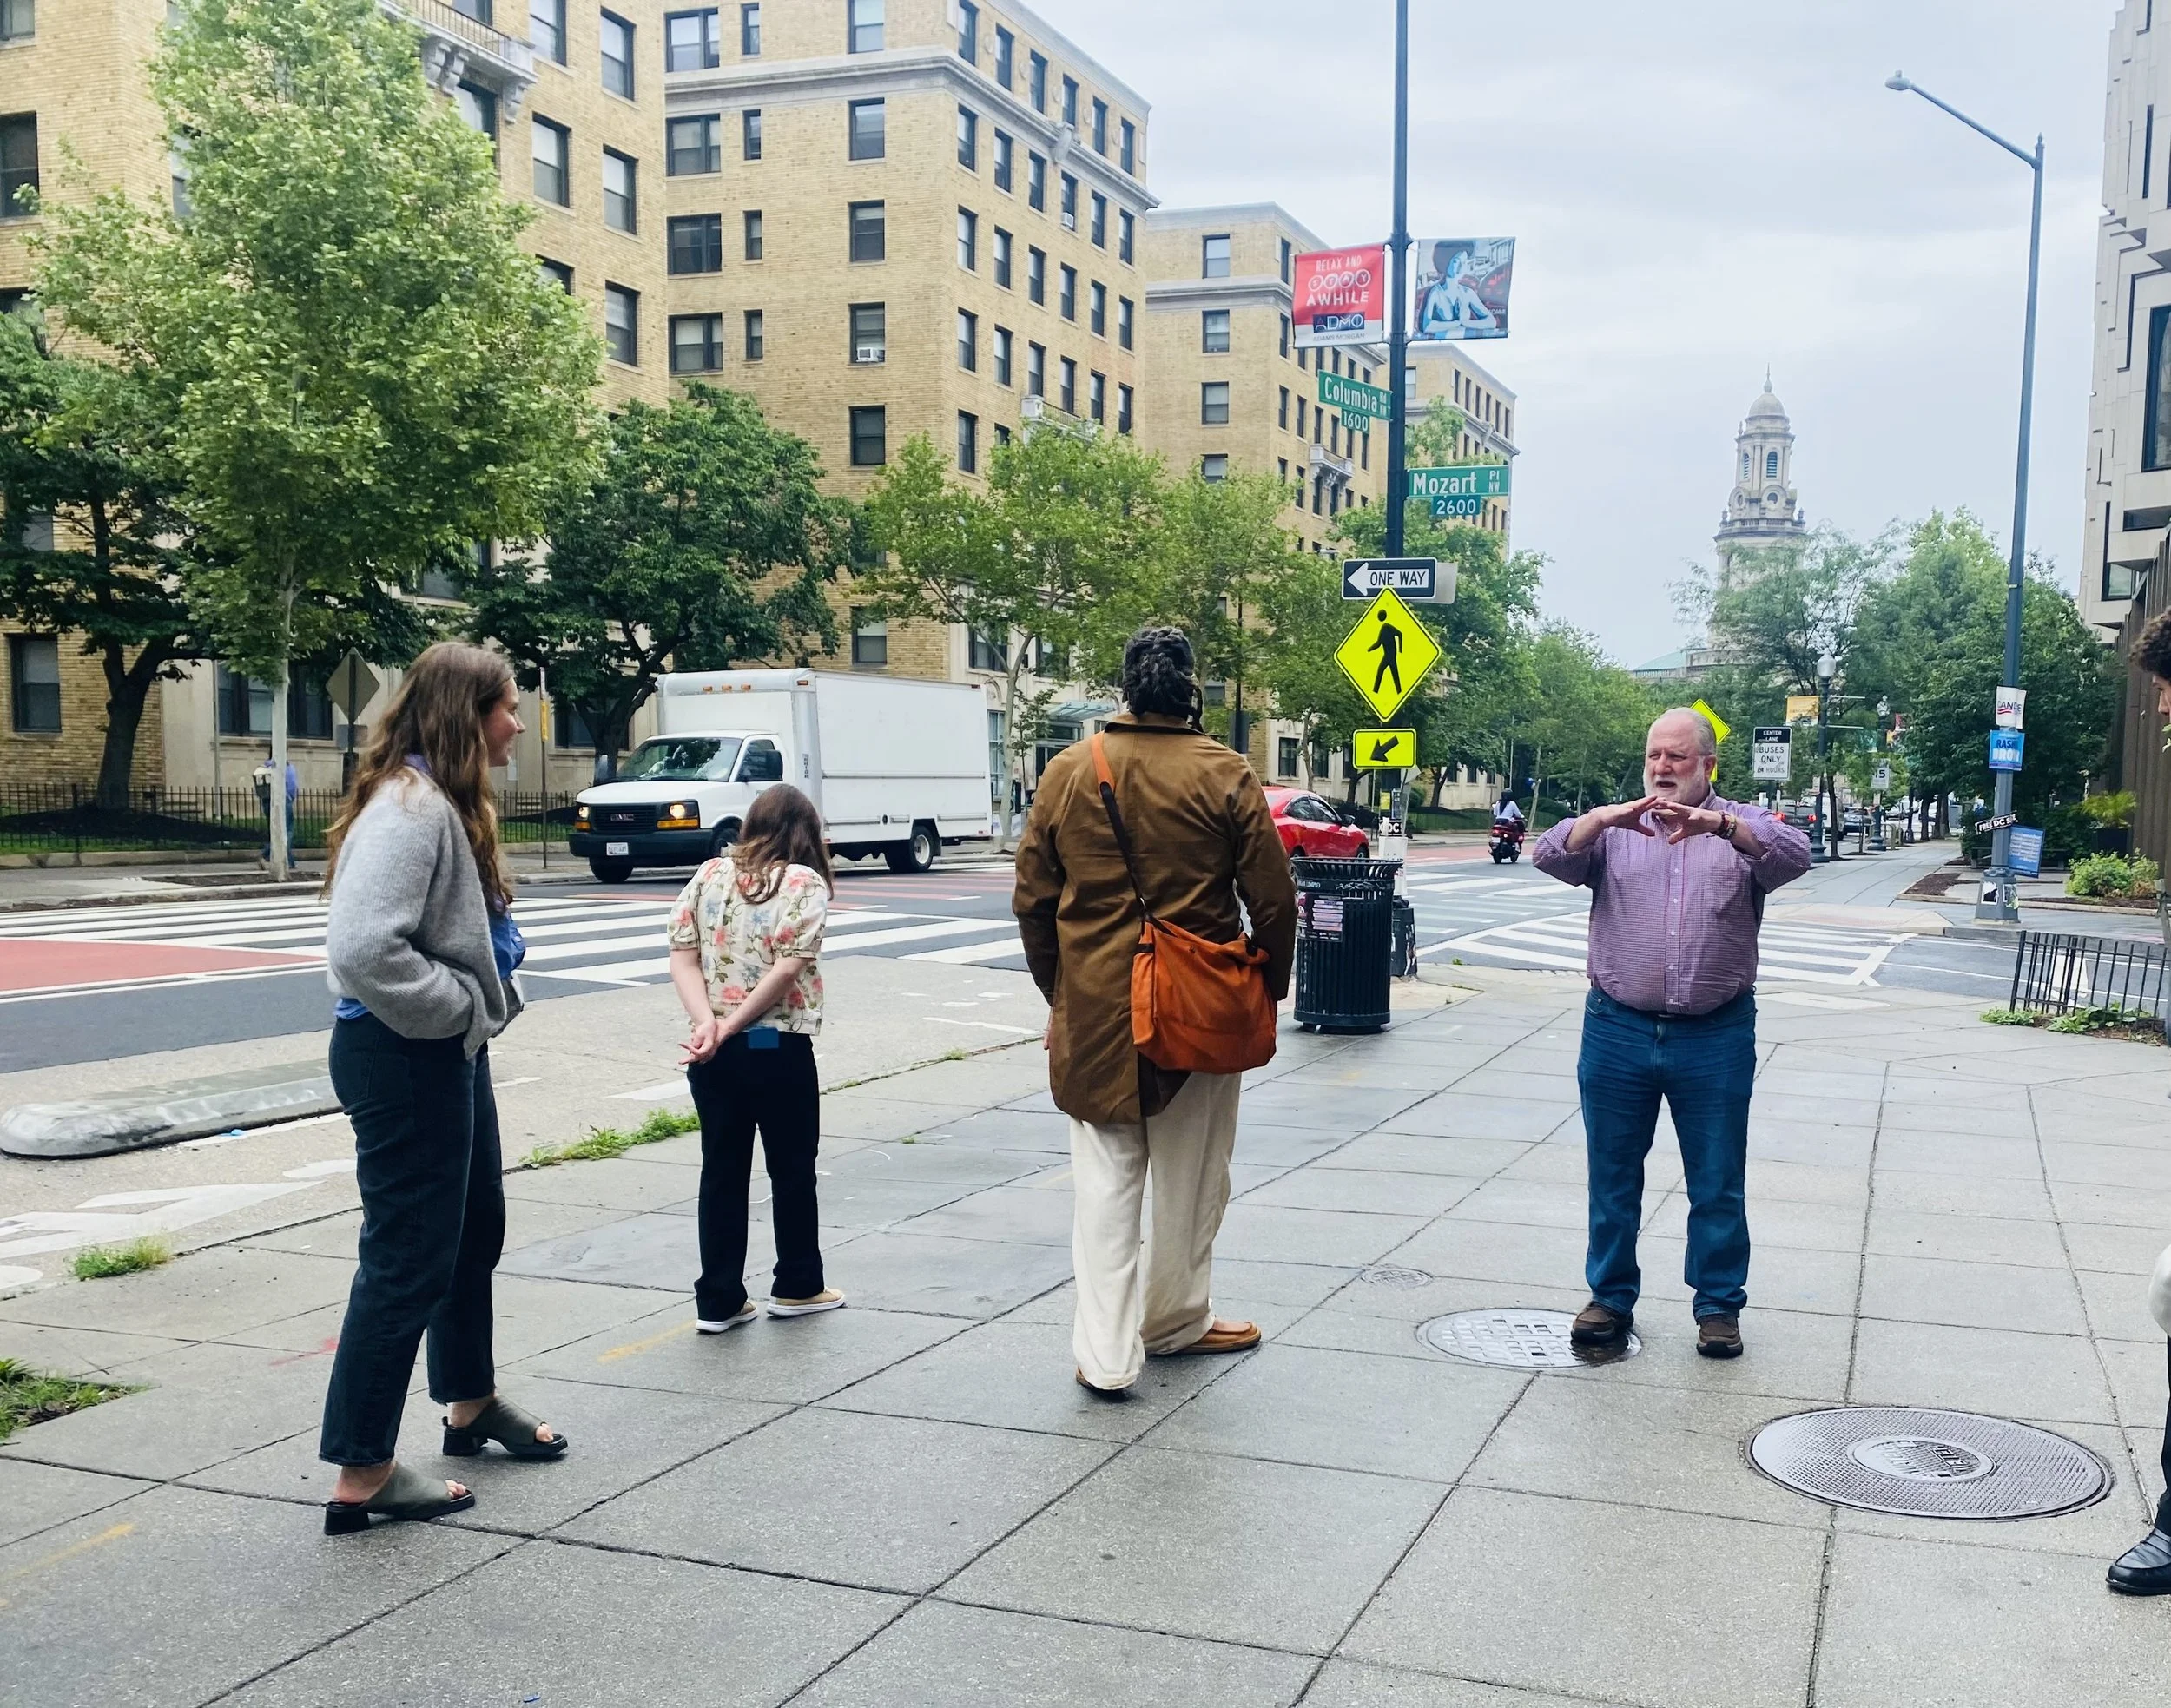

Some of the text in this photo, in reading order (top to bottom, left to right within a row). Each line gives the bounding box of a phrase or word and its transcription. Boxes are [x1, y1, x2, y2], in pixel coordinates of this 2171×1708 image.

[1316, 255, 1362, 272] RELAX AND
[1310, 271, 1369, 289] STAY
[1306, 290, 1369, 307] AWHILE
[1315, 313, 1363, 331] ADMO
[1324, 376, 1377, 412] Columbia
[1343, 411, 1369, 432] 1600
[1413, 470, 1500, 495] Mozart Pl
[1488, 481, 1500, 492] NW
[1436, 498, 1476, 515] 2600
[1369, 571, 1427, 586] ONE WAY
[1760, 755, 1782, 763] ONLY
